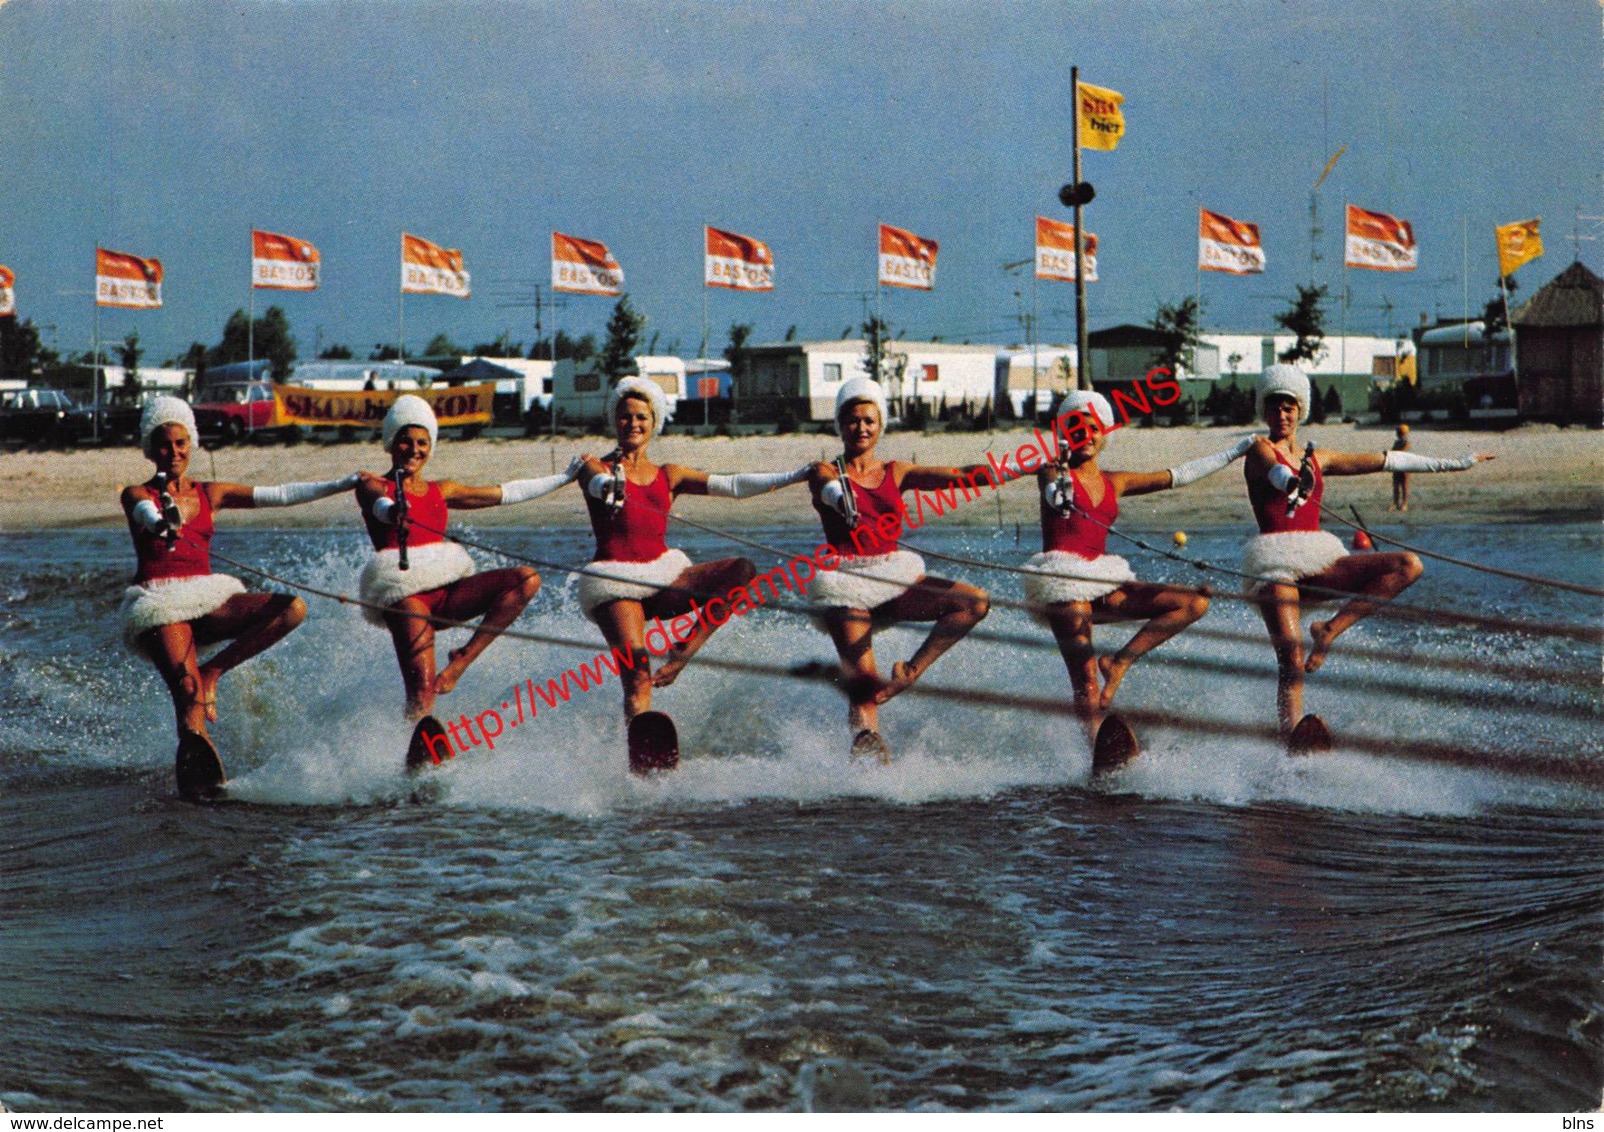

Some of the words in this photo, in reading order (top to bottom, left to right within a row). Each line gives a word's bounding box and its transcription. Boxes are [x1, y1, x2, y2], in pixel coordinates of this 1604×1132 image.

[258, 265, 317, 281] BASTOS
[712, 262, 769, 282] BASTOS
[100, 282, 157, 301] BASTOS
